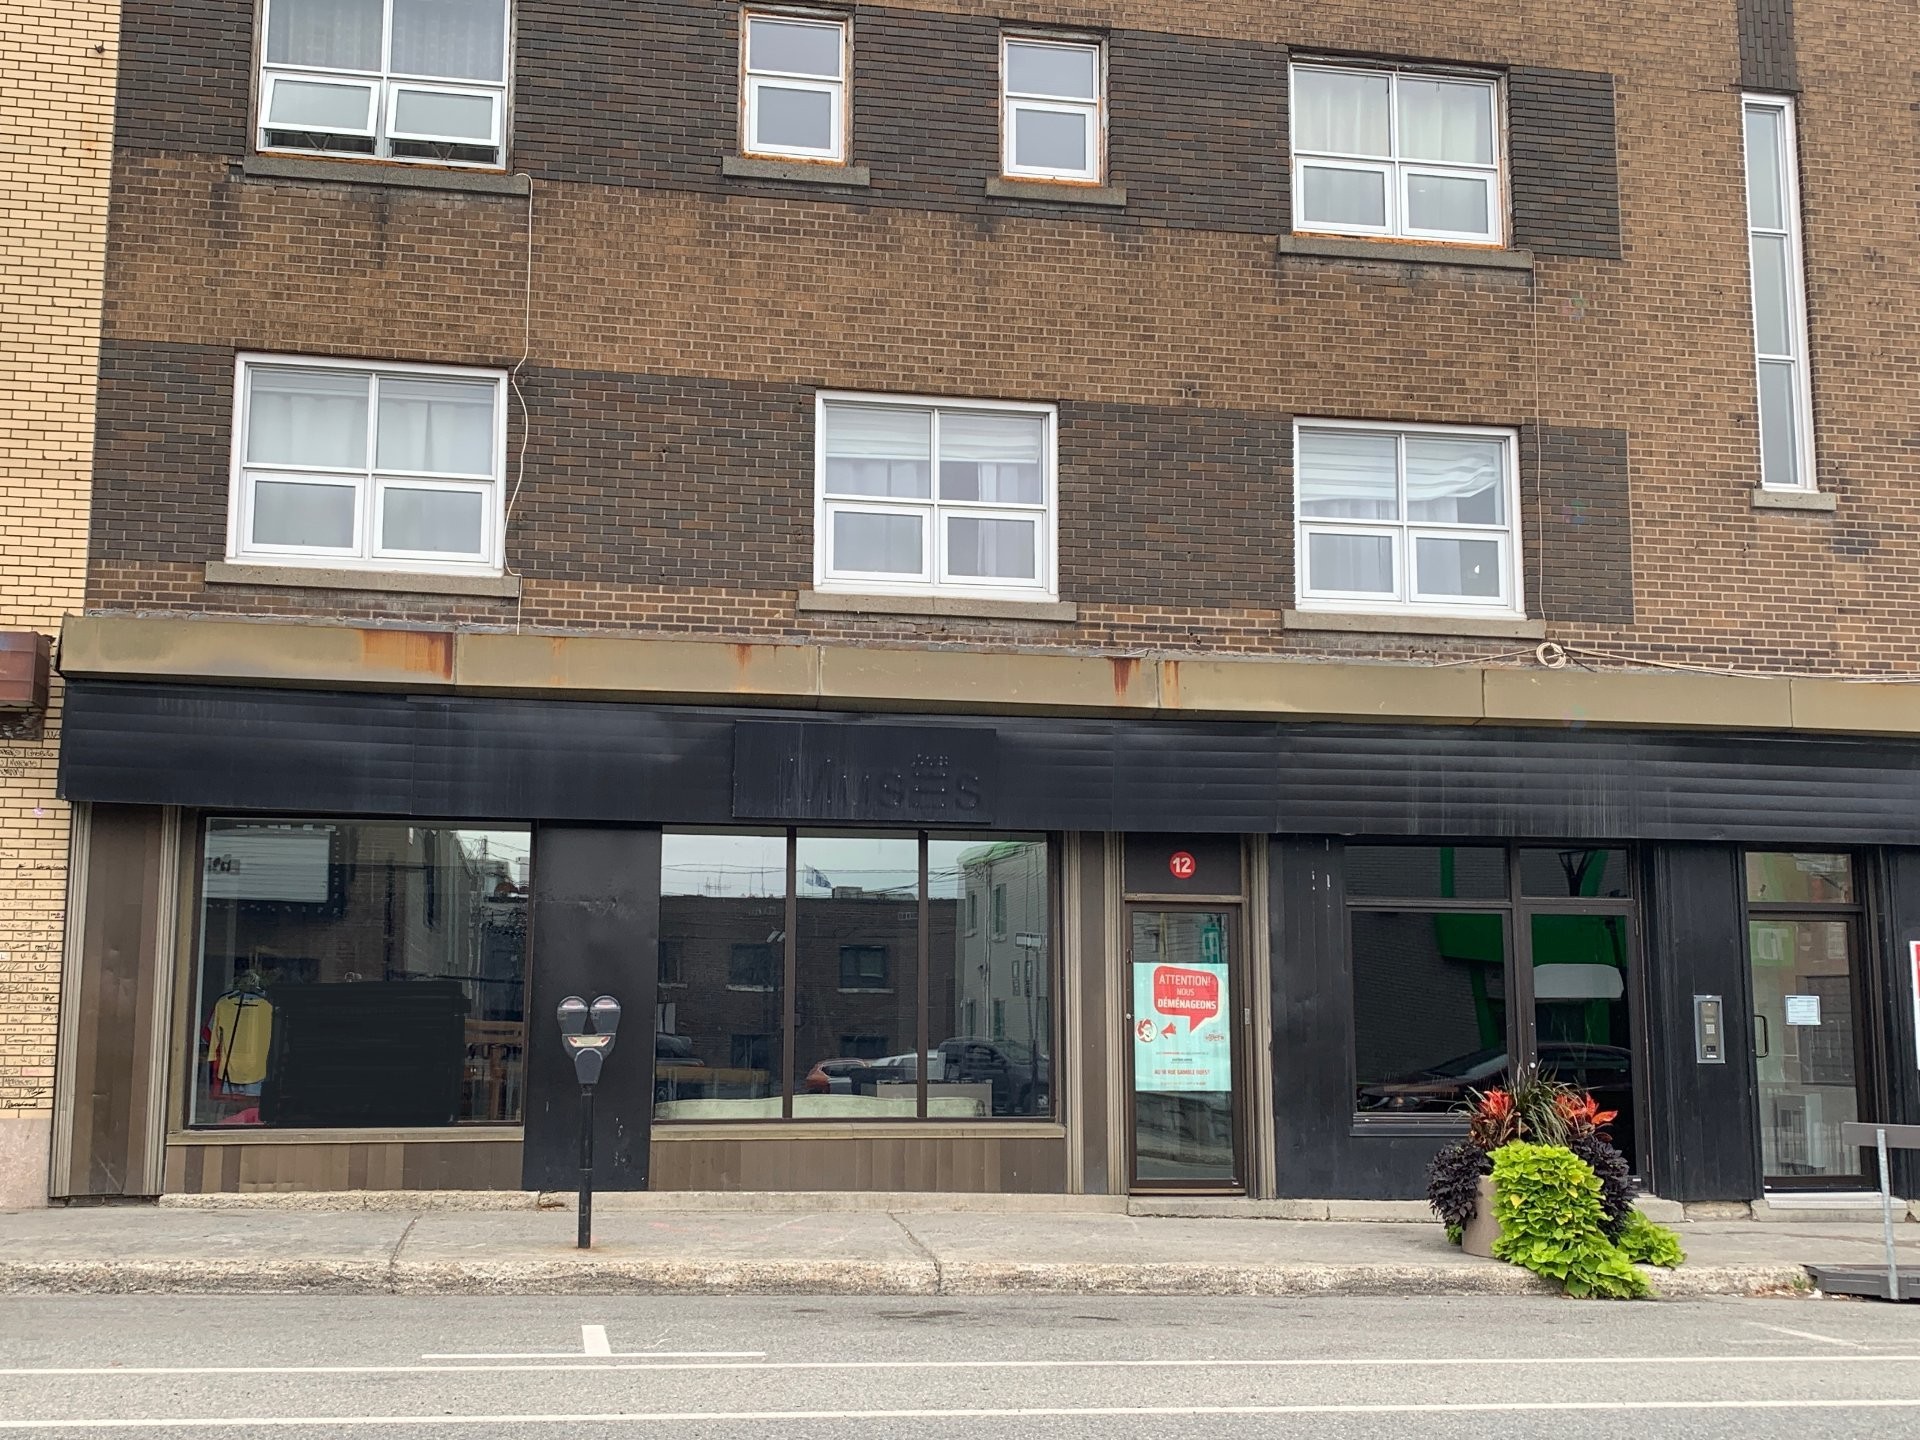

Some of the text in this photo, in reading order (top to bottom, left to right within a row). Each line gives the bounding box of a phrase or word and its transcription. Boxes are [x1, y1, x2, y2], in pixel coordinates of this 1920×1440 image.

[1173, 857, 1192, 873] 12
[1158, 974, 1211, 987] ATTENTION!
[1176, 987, 1195, 997] NOUS
[1157, 996, 1217, 1010] DÉMÉNAGEONS
